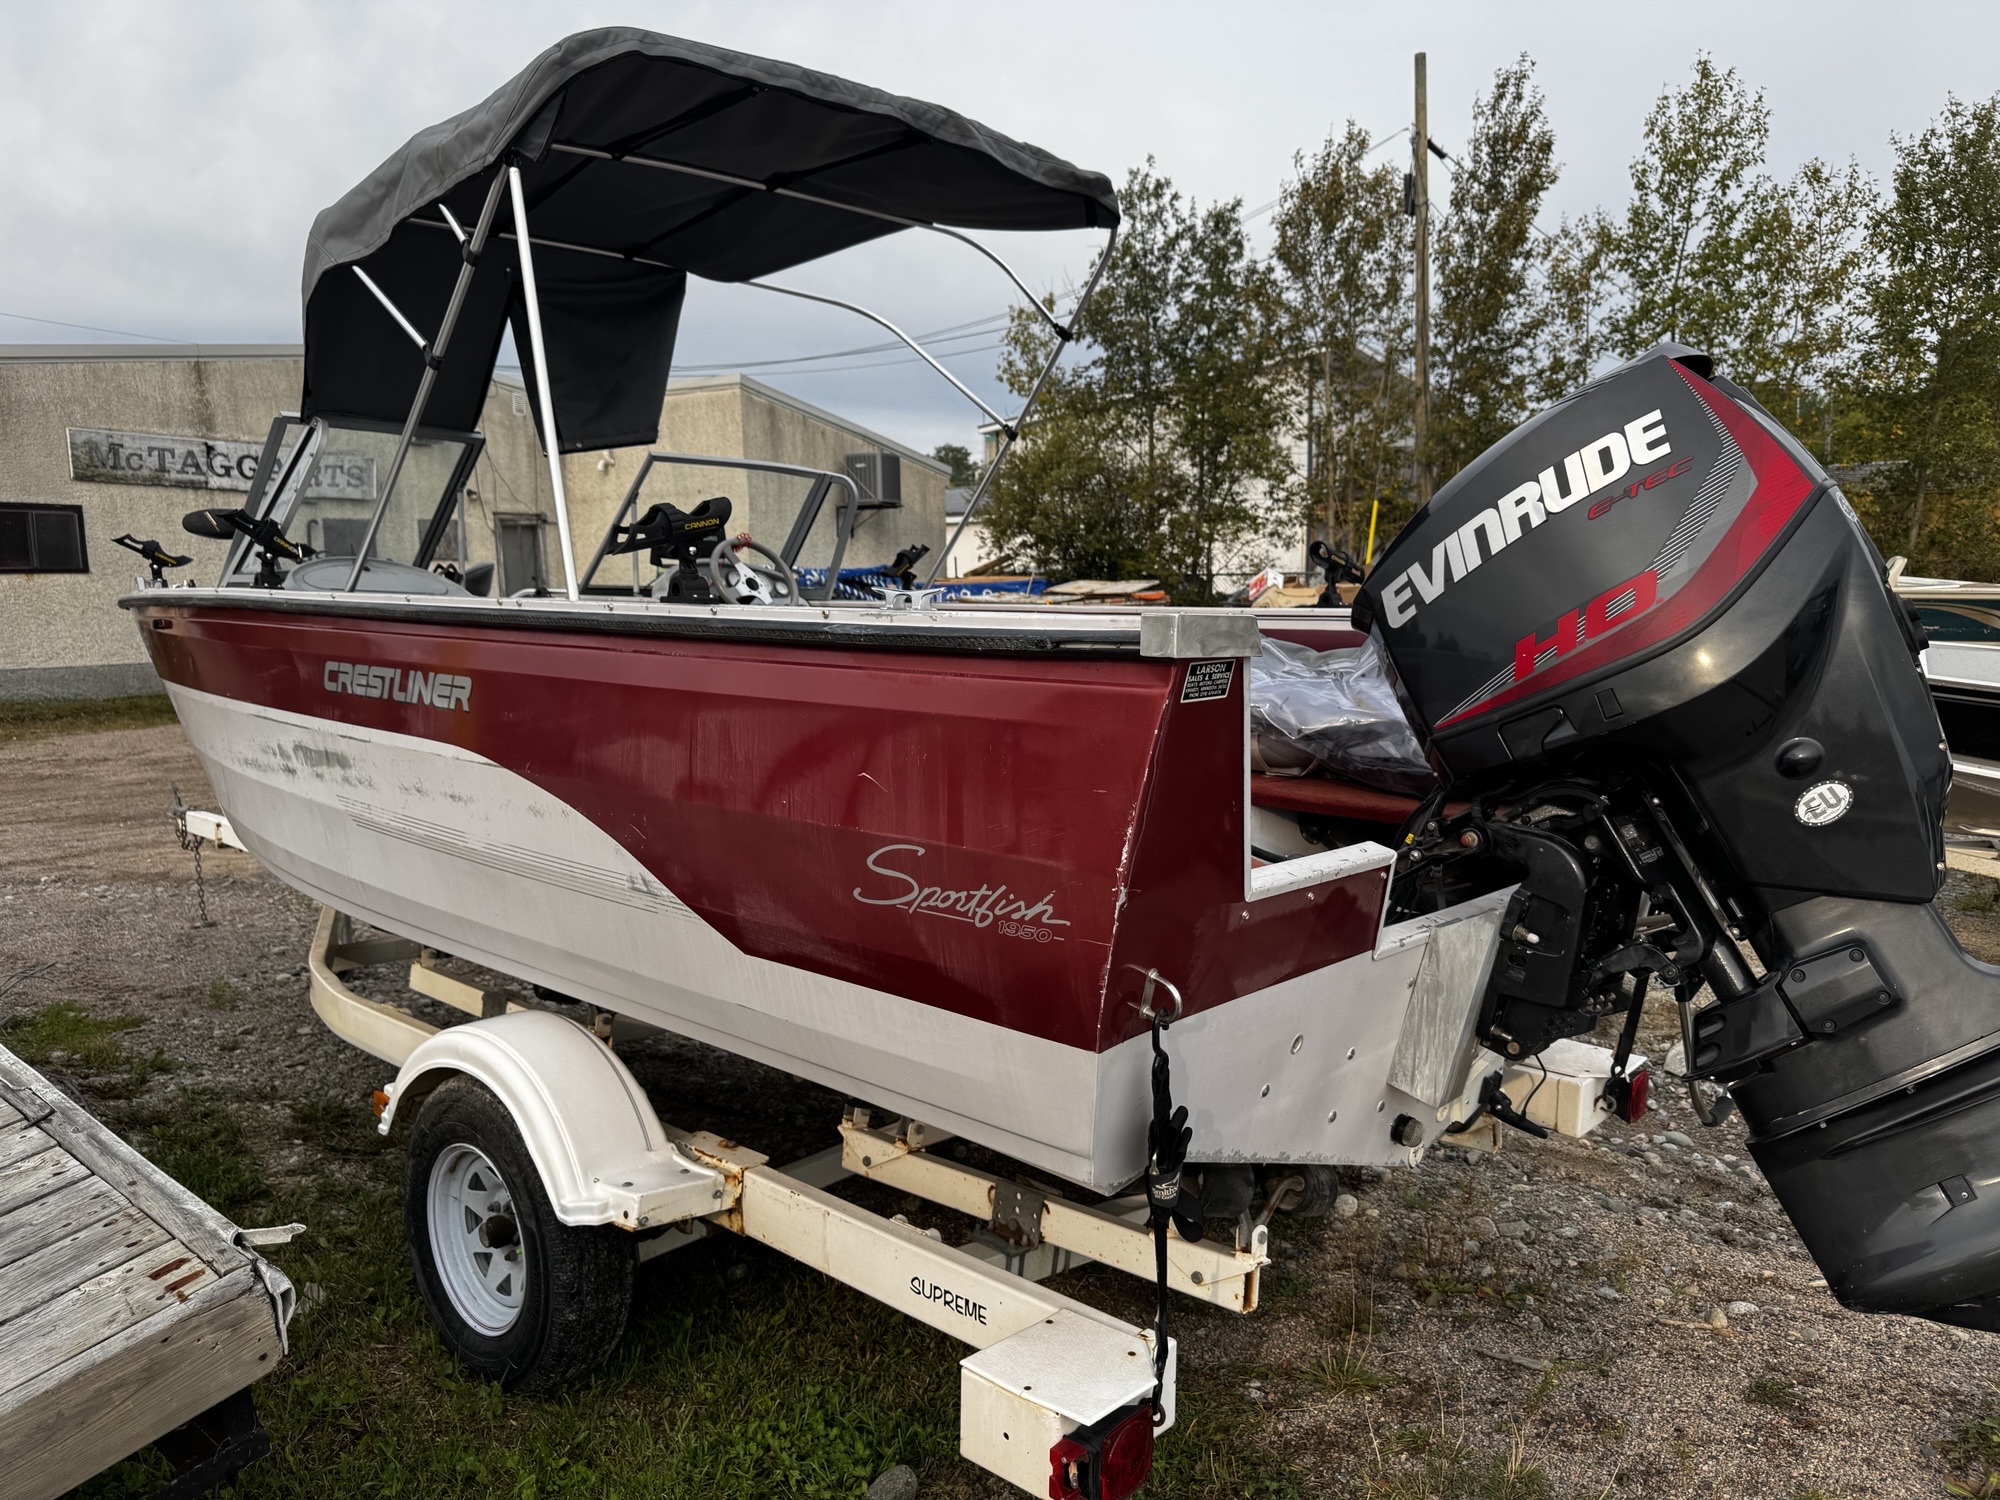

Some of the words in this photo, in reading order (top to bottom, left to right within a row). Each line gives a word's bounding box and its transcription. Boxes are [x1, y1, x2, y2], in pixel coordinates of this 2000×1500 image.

[1587, 456, 1693, 520] E-TEC
[684, 517, 719, 530] CANNON
[1380, 408, 1672, 629] EVINRUDE
[323, 660, 472, 712] CRESTLINER
[1188, 674, 1203, 682] SALES
[1211, 672, 1230, 680] SERVICE
[1196, 664, 1226, 674] LARSON
[1803, 786, 1842, 820] EU
[853, 844, 1071, 928] Sportfish
[998, 921, 1052, 943] 1950
[909, 1276, 987, 1326] SUPREME
